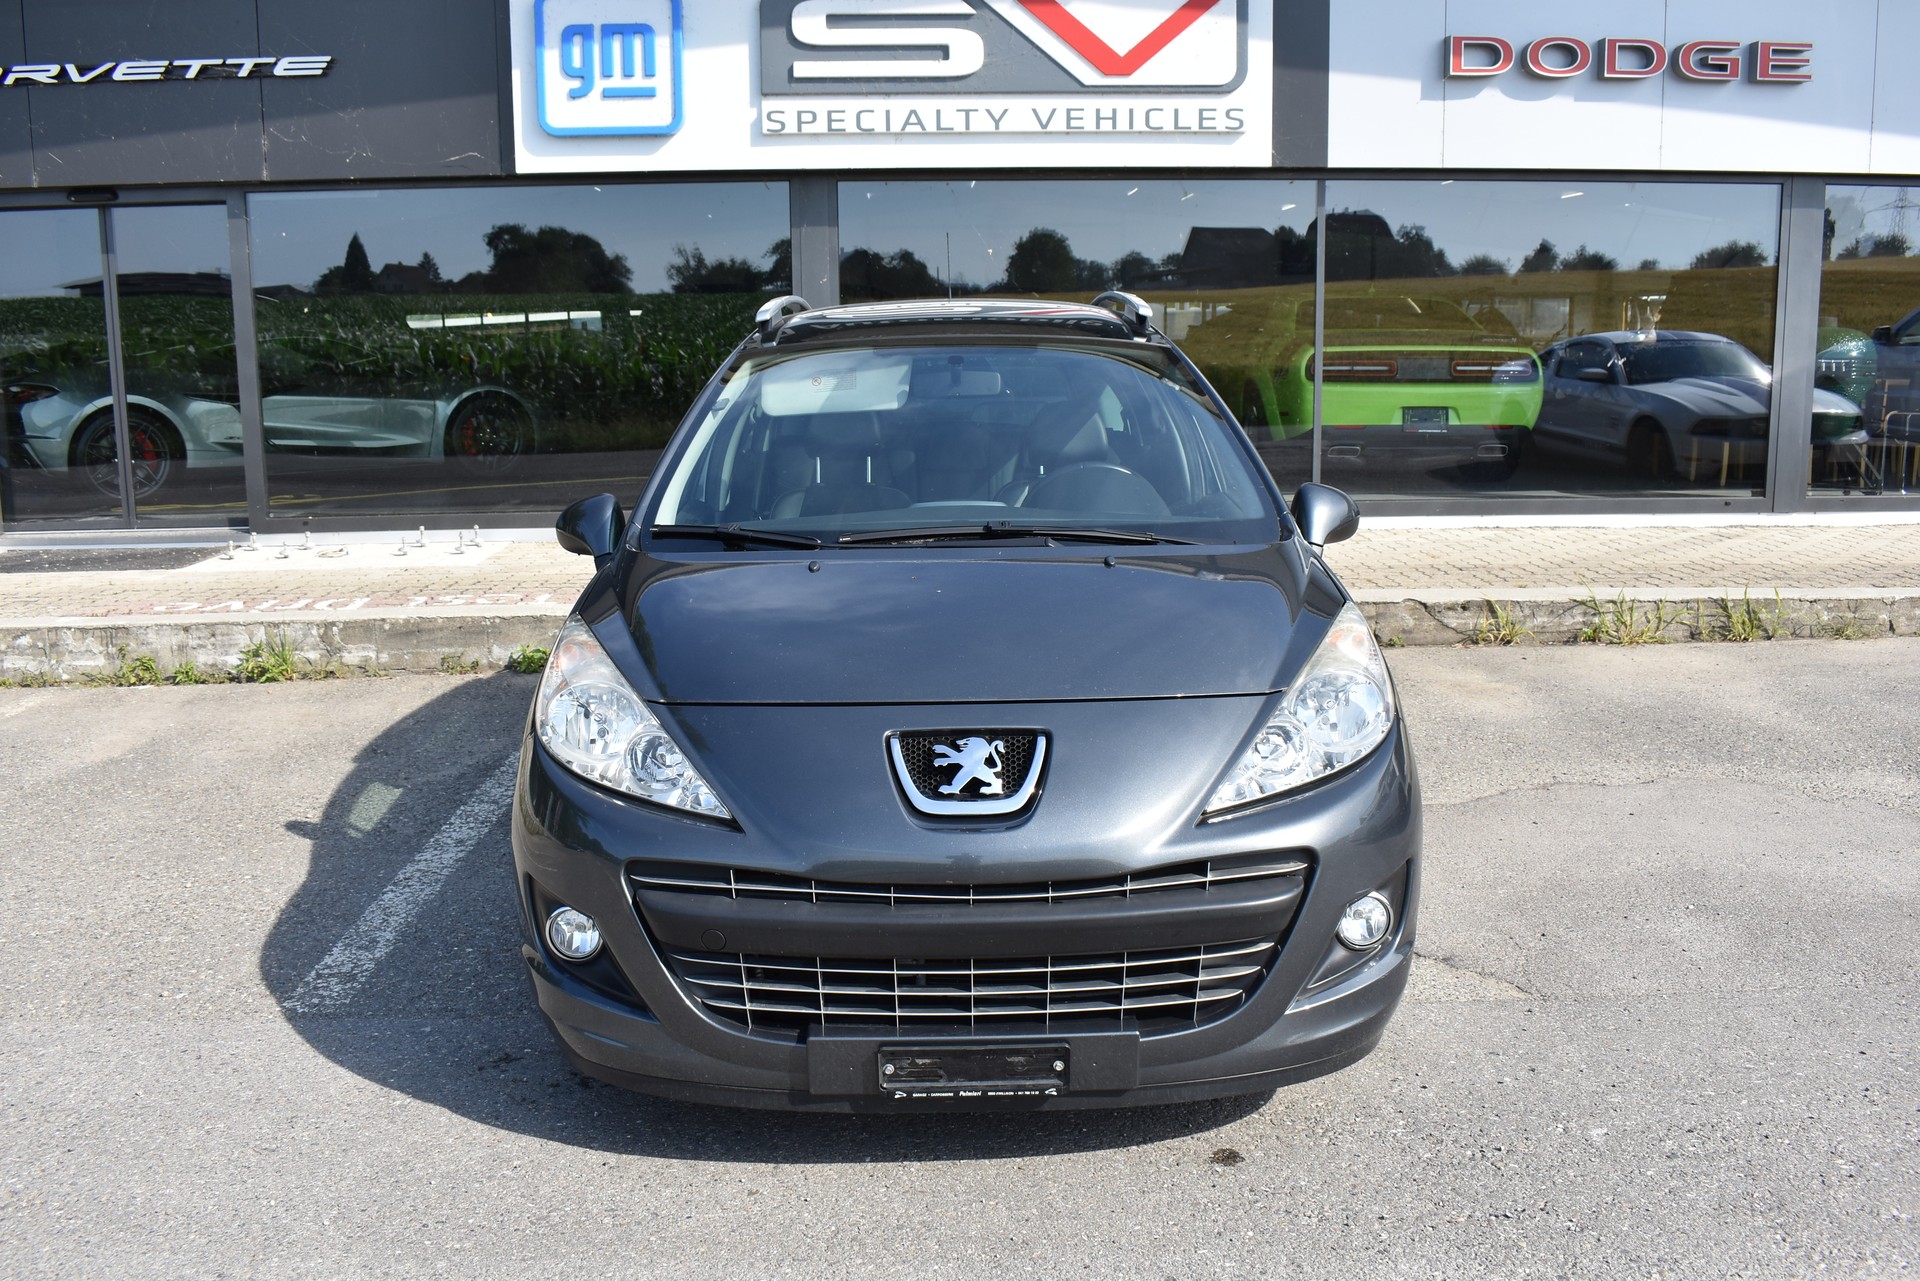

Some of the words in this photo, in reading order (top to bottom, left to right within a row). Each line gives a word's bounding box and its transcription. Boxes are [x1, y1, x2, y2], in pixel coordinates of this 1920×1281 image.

[0, 55, 332, 85] RVETTE
[560, 22, 657, 99] gm
[1446, 35, 1813, 82] DODGE
[766, 108, 1009, 133] SPECIALTY
[1031, 107, 1245, 131] VEHICLES
